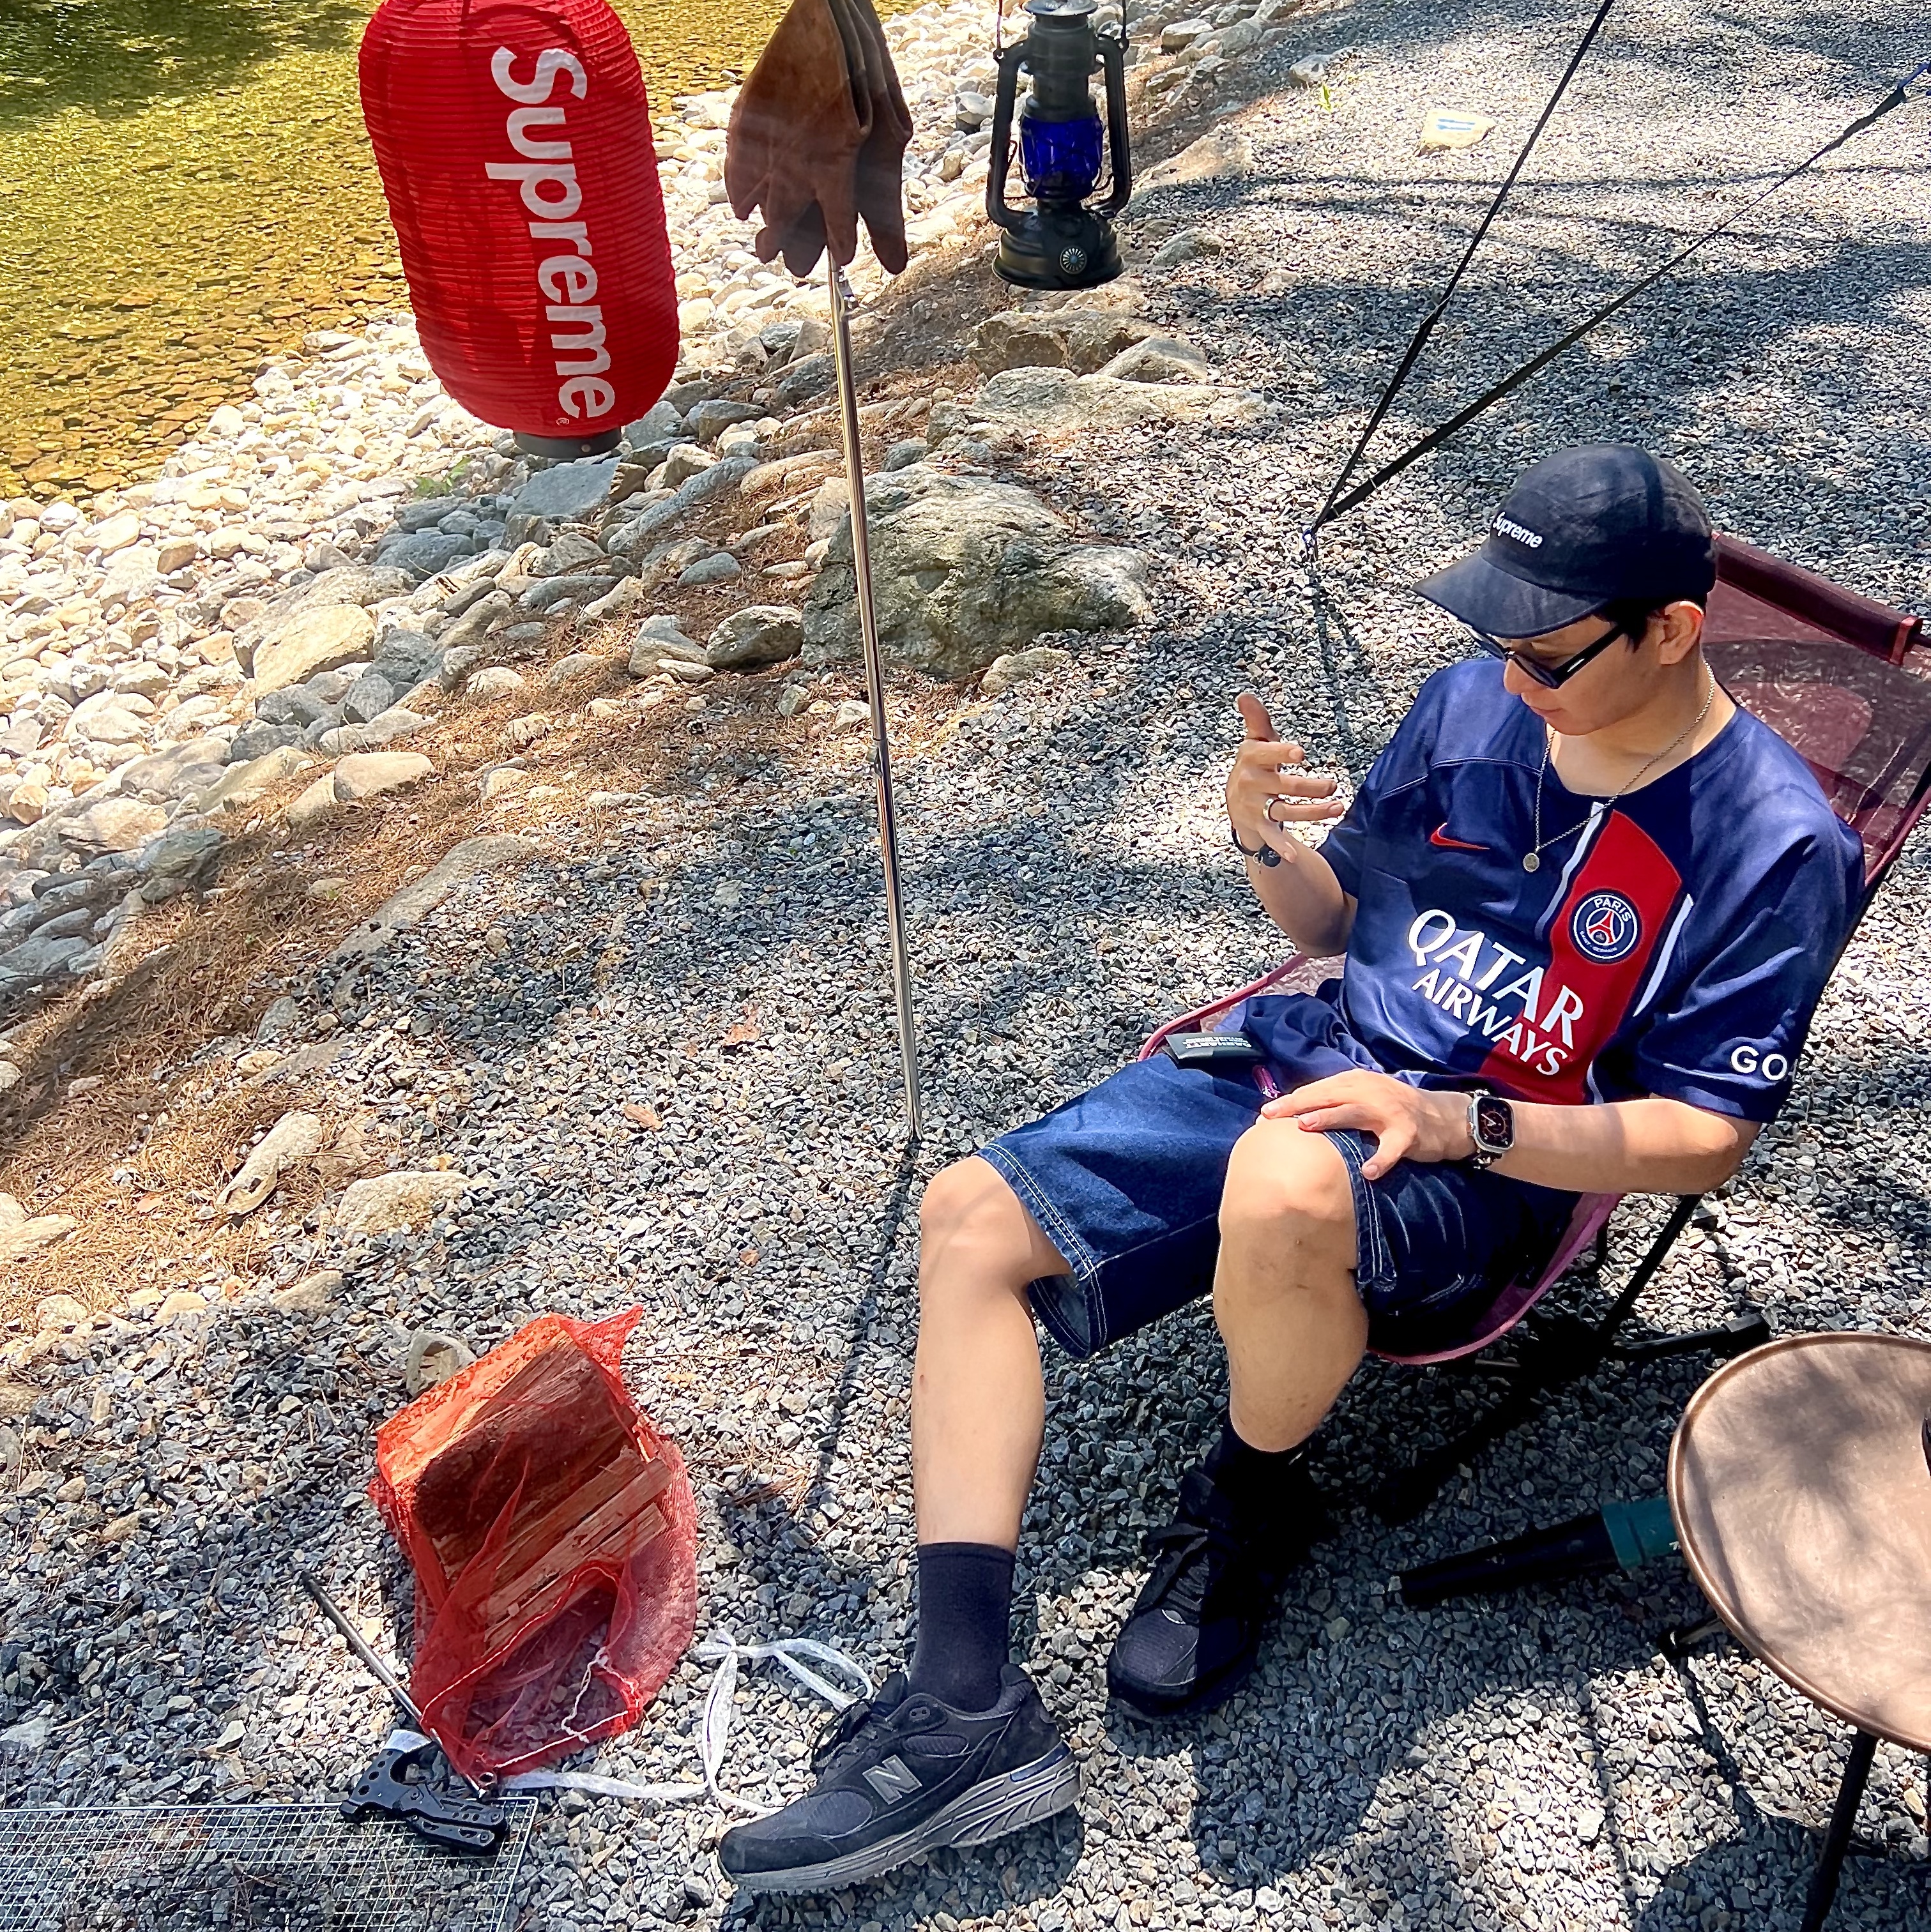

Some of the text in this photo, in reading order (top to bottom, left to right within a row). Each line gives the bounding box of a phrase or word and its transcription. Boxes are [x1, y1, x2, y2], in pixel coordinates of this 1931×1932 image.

[485, 46, 615, 420] Supreme
[1492, 512, 1543, 548] Supreme
[1594, 897, 1632, 922] PARIS
[1408, 909, 1574, 1050] QATAR
[1411, 968, 1568, 1076] AIRWAYS
